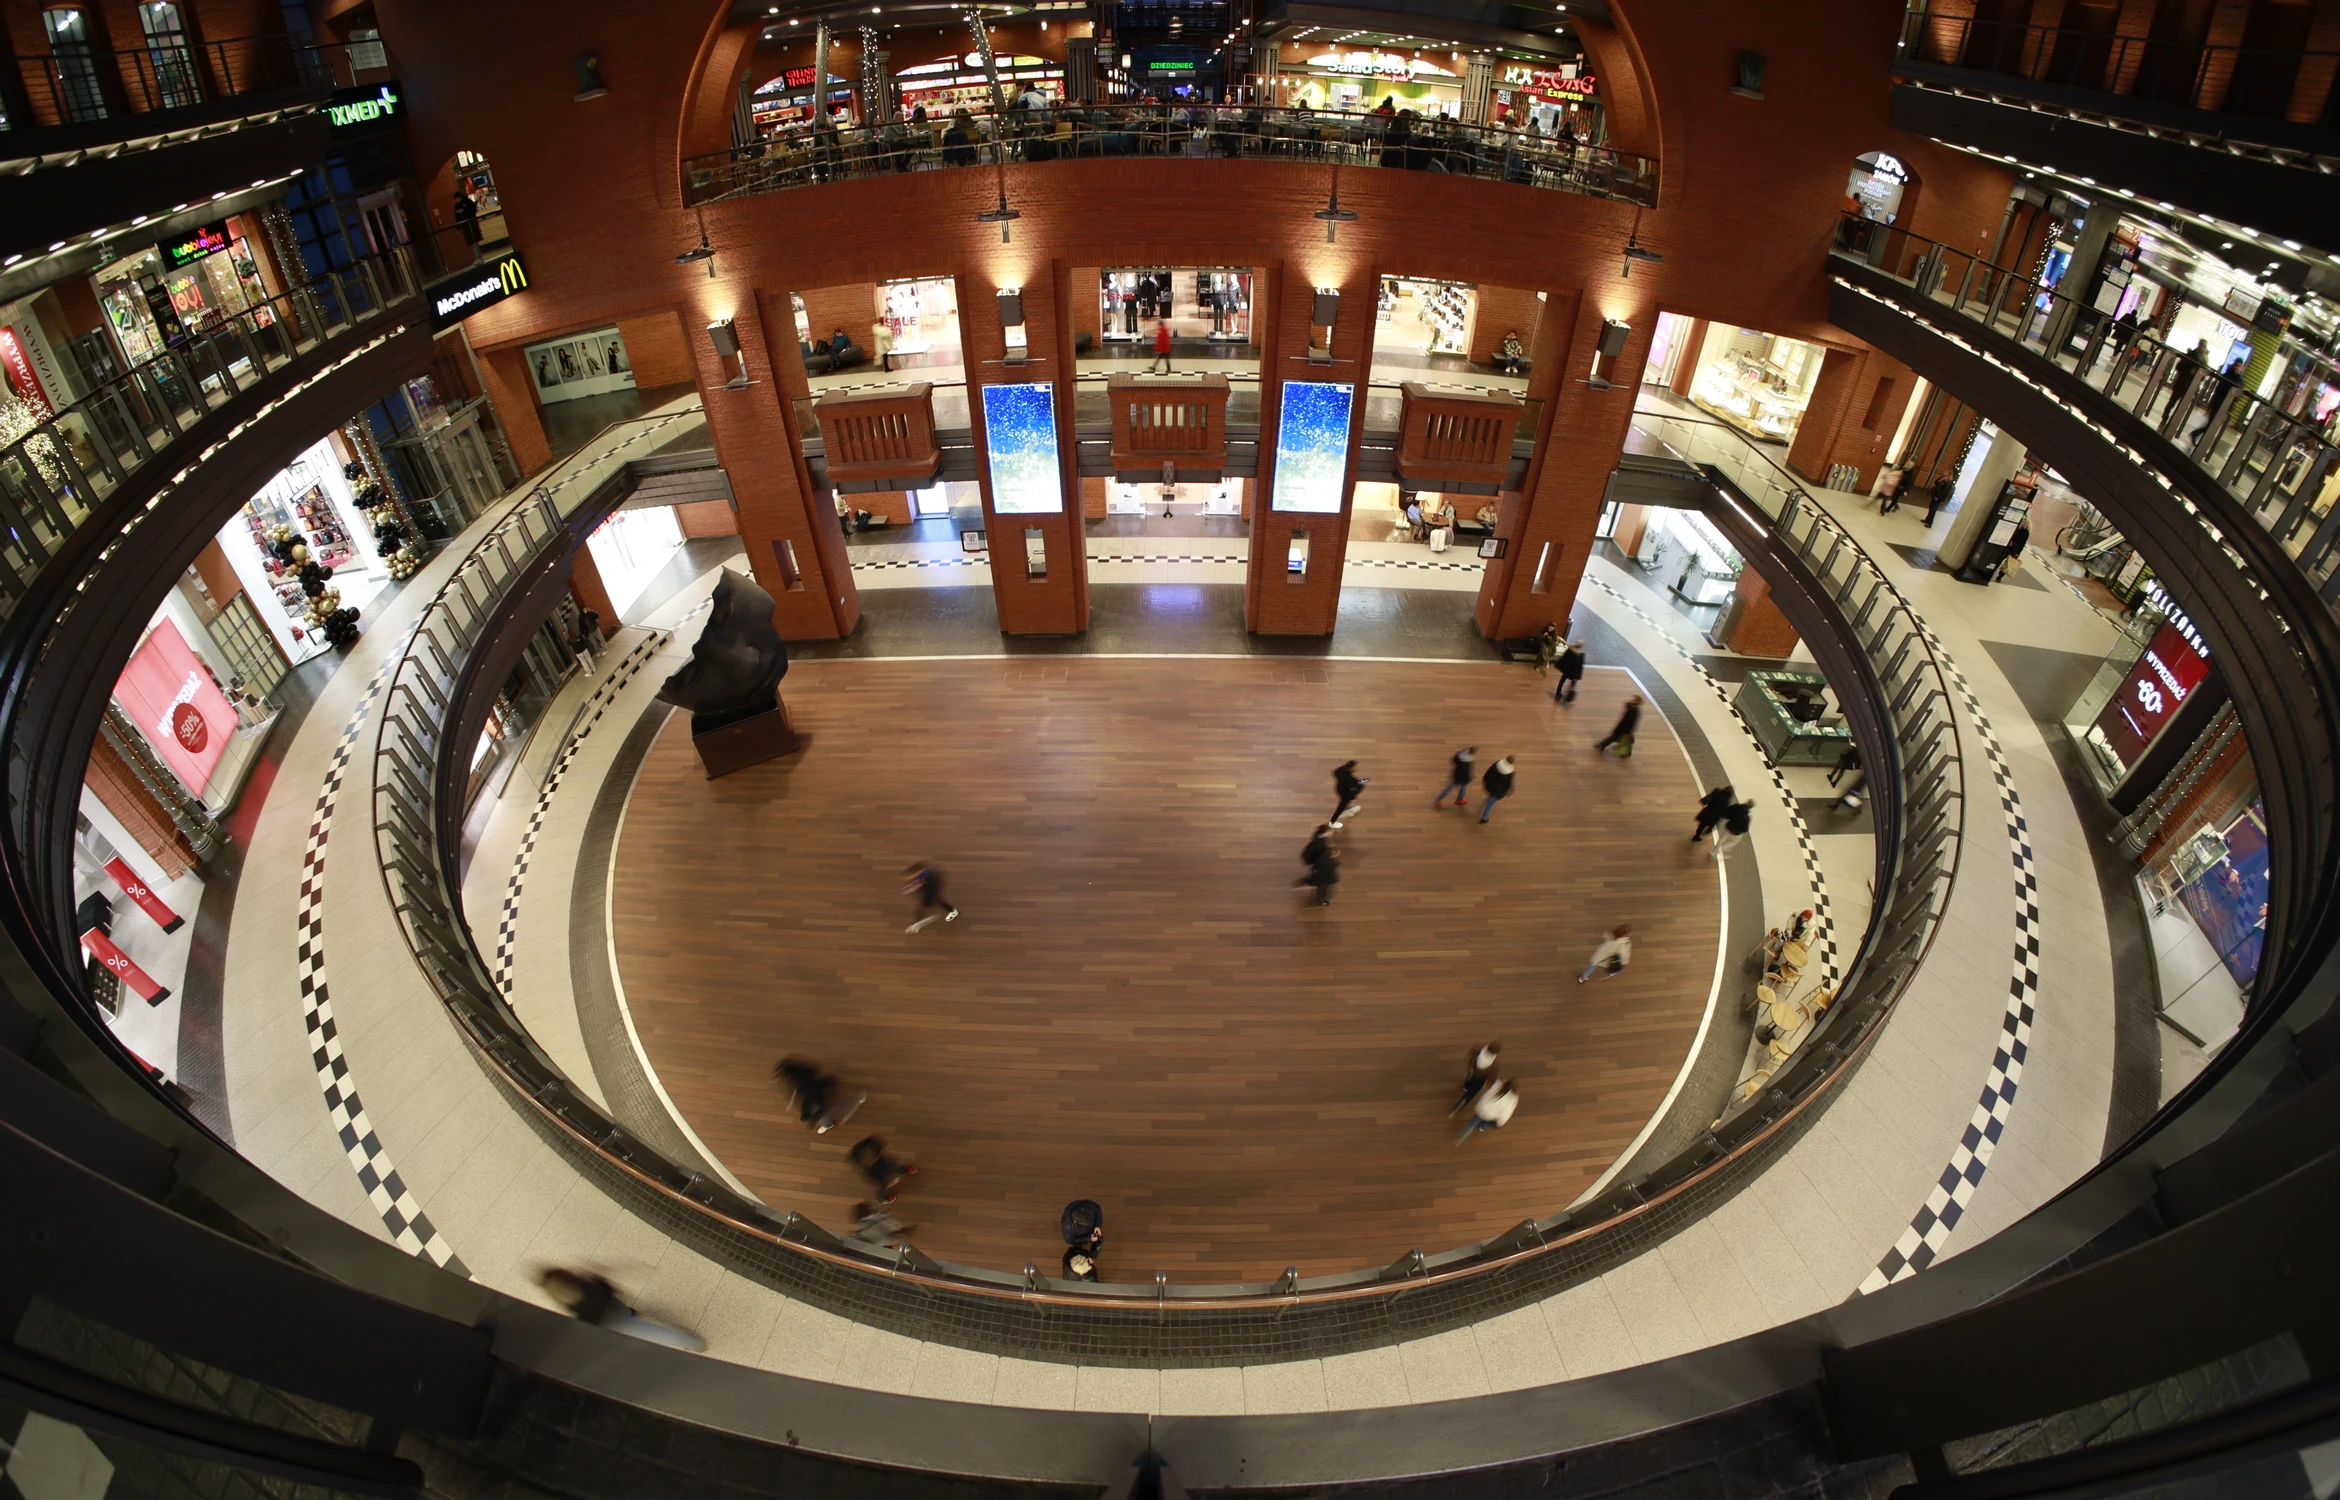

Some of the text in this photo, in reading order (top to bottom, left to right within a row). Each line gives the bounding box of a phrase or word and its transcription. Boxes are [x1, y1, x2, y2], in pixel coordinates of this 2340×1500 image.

[787, 75, 816, 87] HOUS
[1504, 66, 1596, 94] HA LONG
[1518, 84, 1583, 102] Asian Express
[323, 100, 380, 126] XMED
[2132, 229, 2140, 242] 2
[193, 250, 208, 258] drink
[437, 277, 502, 316] McDonald's
[885, 316, 917, 328] SALE
[2145, 650, 2187, 701] WYPRZEDAŻ
[2198, 882, 2209, 912] Tailoring
